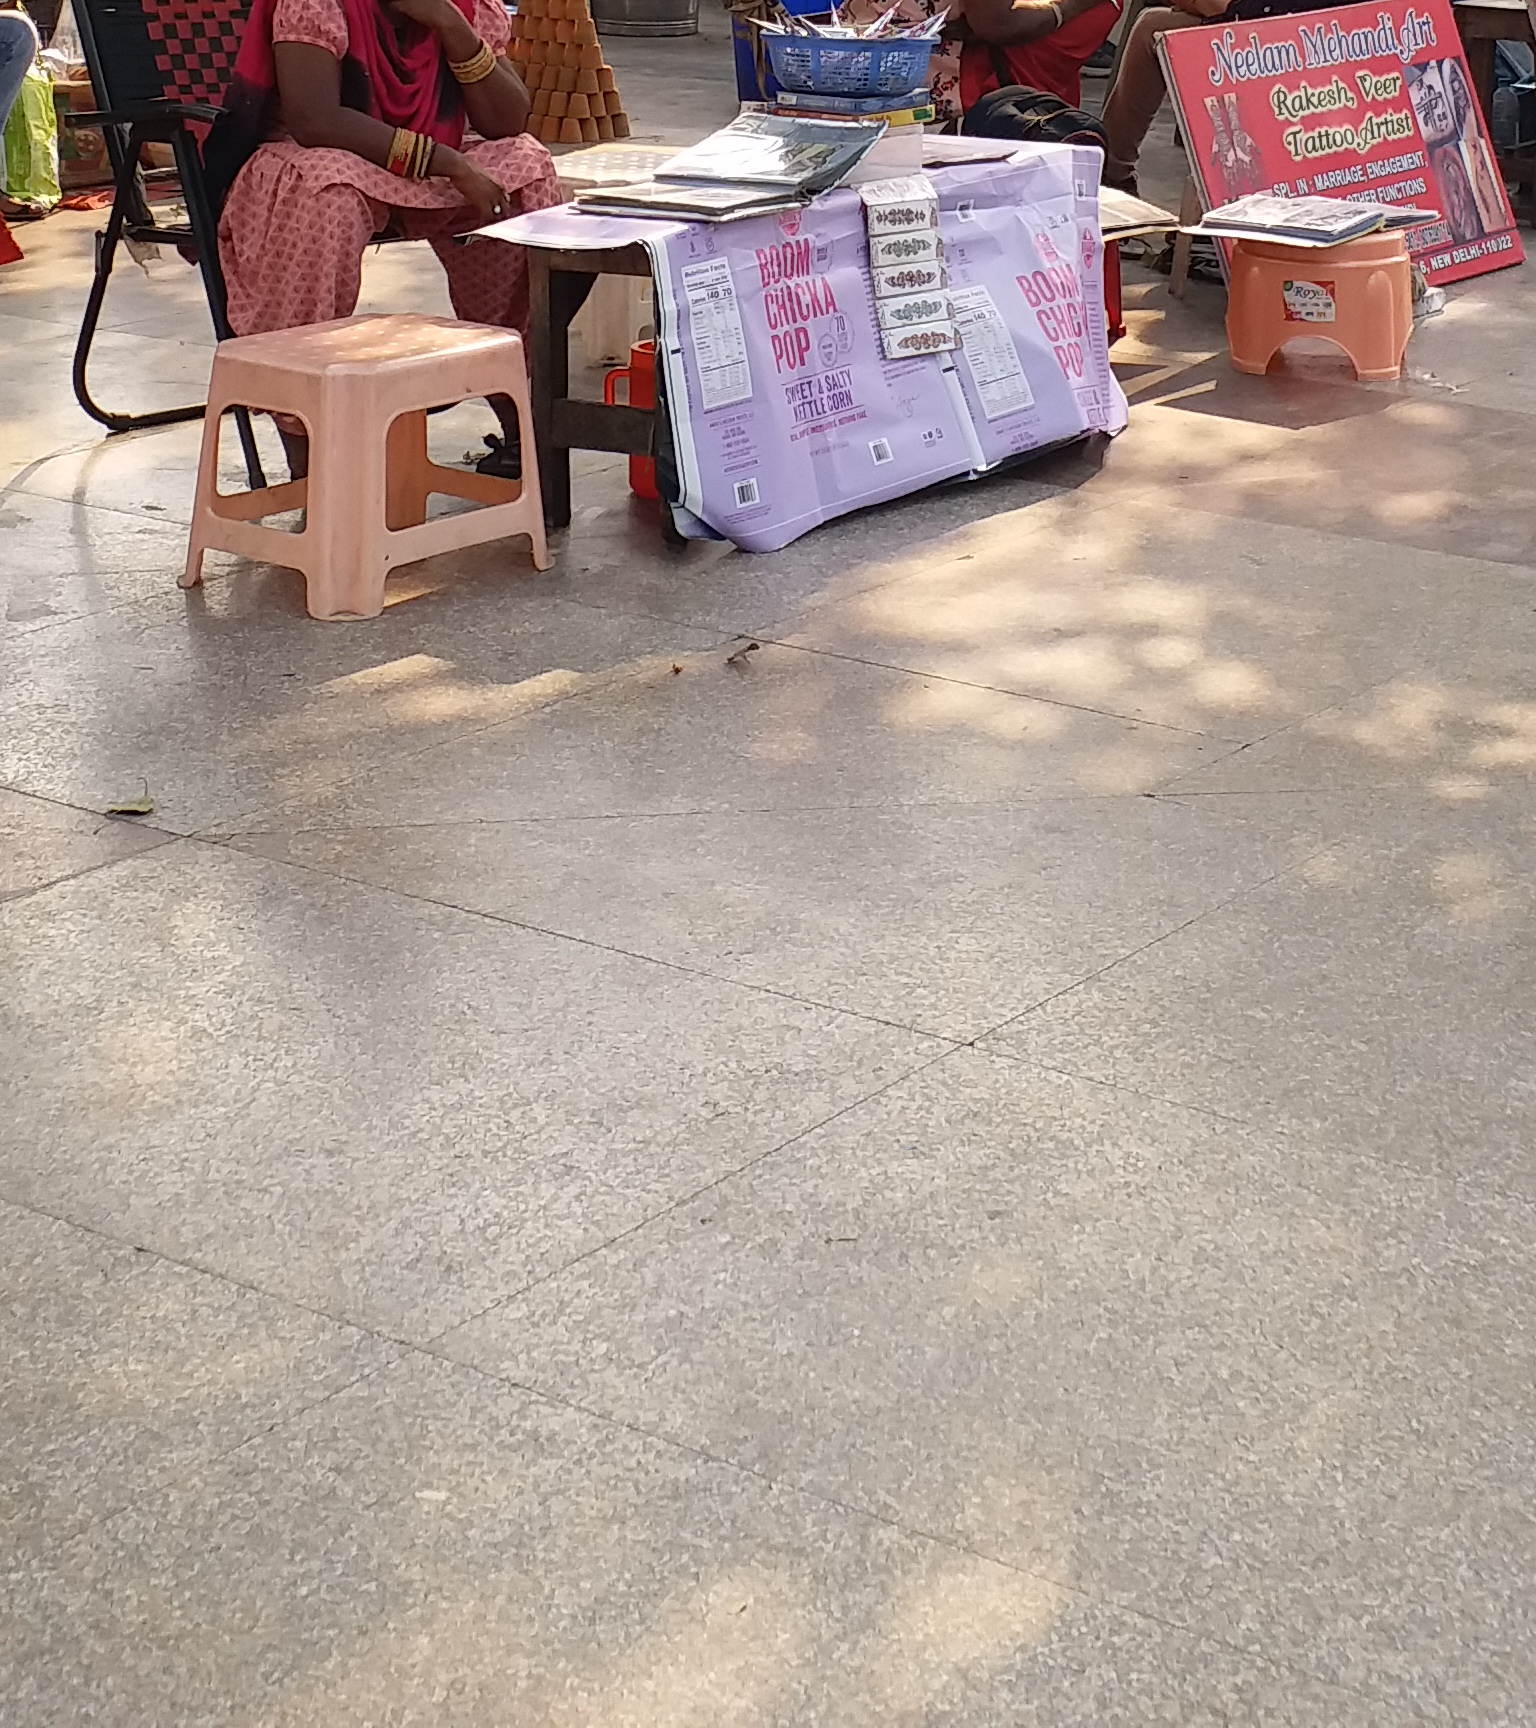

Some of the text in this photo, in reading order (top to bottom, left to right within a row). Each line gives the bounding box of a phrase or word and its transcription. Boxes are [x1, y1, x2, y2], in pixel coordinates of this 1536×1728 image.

[1211, 10, 1436, 85] Neelam Mehandi Art
[1272, 72, 1402, 119] Rakesh, Veer
[1286, 111, 1413, 157] Tattoo Artist
[1296, 178, 1309, 195] IN
[1313, 164, 1368, 192] MARRIAGE,
[1366, 151, 1429, 180] ENGAGEMENT,
[1377, 177, 1427, 203] FUNCTIONS
[755, 237, 811, 289] BOOM
[1430, 254, 1452, 271] NEW
[707, 290, 720, 301] 140
[722, 287, 733, 297] 70
[763, 277, 838, 331] CHICKA
[1016, 264, 1079, 309] BOOM
[1293, 286, 1329, 300] Royal
[833, 316, 846, 332] 70
[770, 326, 811, 375] POP
[785, 368, 854, 405] SWEET & SALTY
[792, 389, 854, 423] KETTLE CORN
